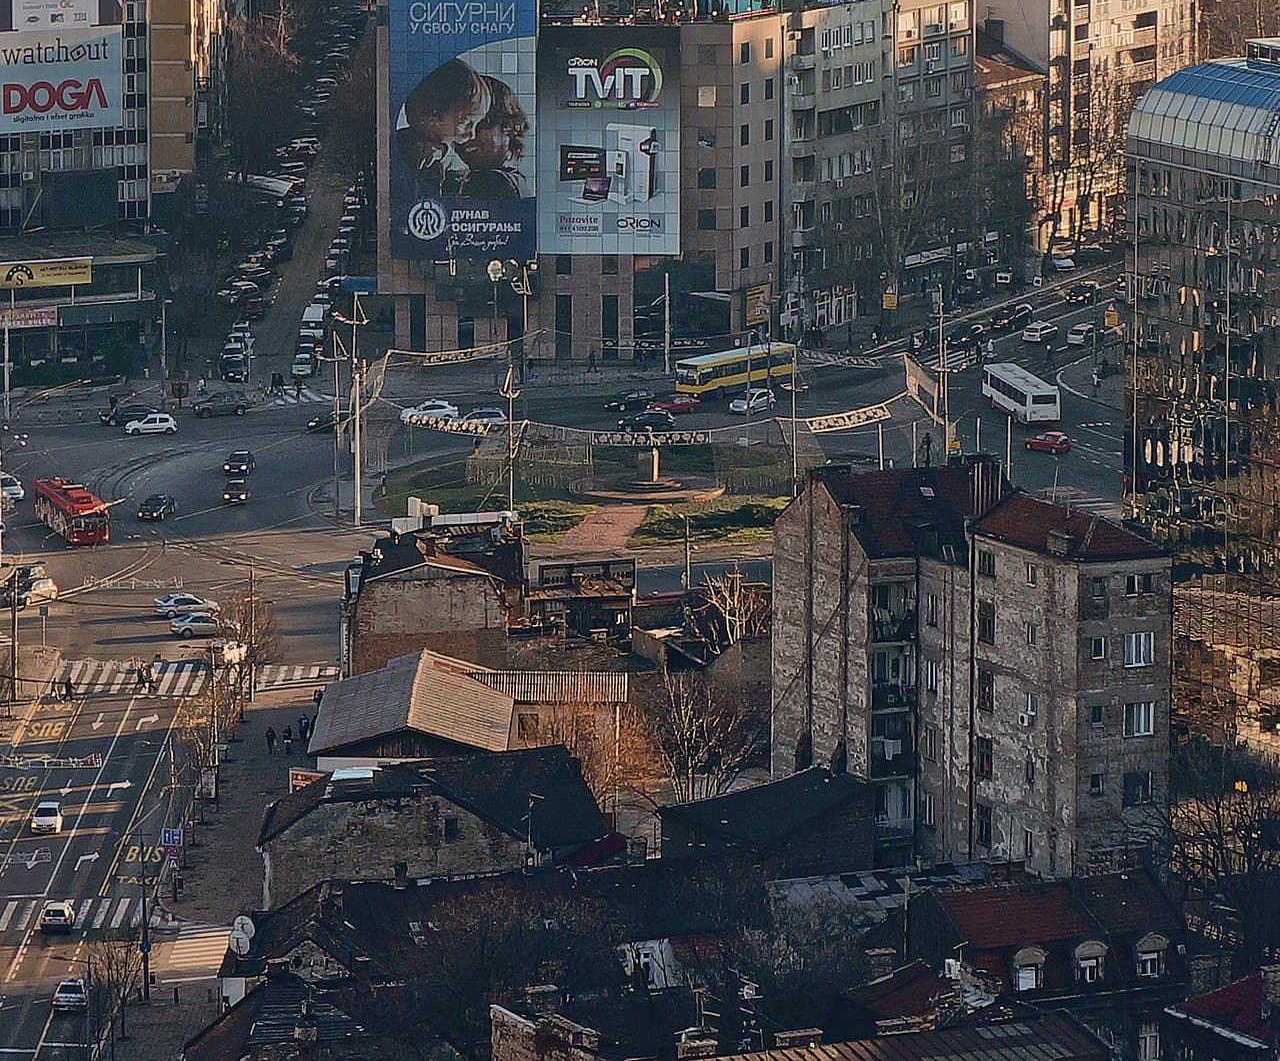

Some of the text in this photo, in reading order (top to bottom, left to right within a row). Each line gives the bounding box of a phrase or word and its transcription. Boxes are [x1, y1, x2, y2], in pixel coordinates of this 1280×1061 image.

[409, 2, 515, 23] СИГУРНИ
[410, 22, 515, 34] У СВОЈУ СНАГУ
[1, 37, 109, 66] watchout
[3, 78, 109, 114] DOGA
[451, 210, 490, 221] ДУНАВ
[559, 214, 599, 224] Pozovite
[616, 216, 661, 230] ORION
[451, 222, 522, 233] ОСИГУРАЊЕ
[28, 721, 66, 737] BUS
[0, 776, 38, 791] BUS
[124, 845, 165, 863] BUS
